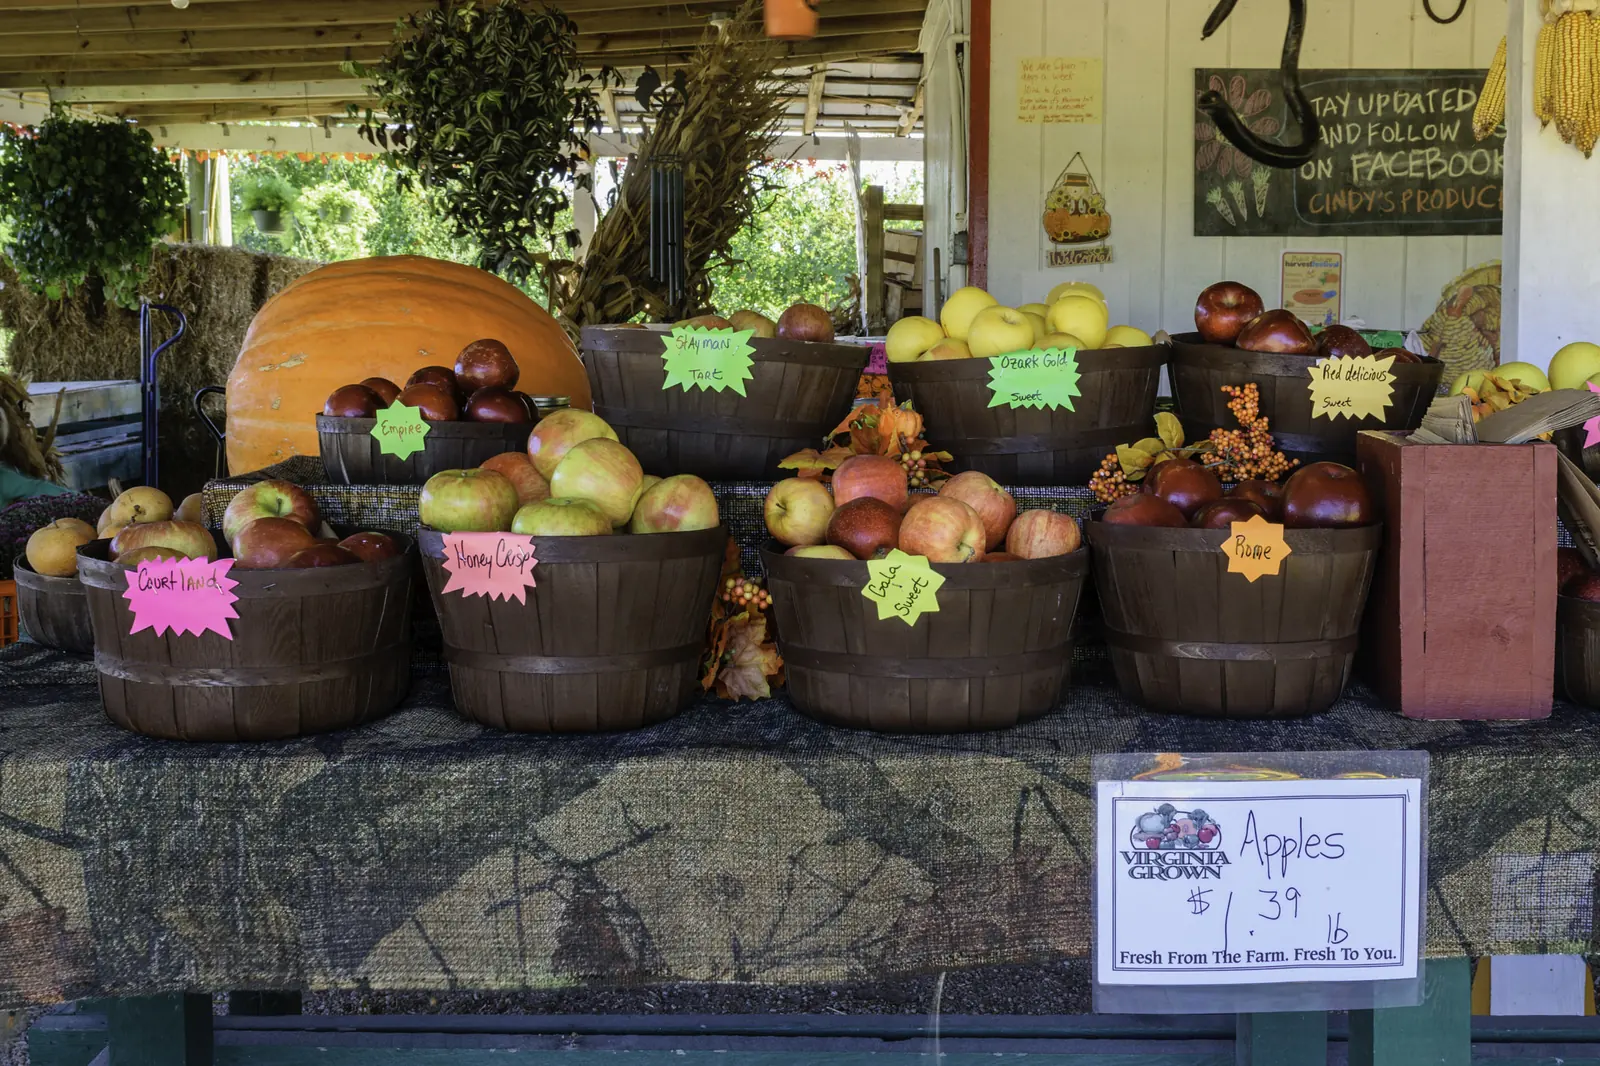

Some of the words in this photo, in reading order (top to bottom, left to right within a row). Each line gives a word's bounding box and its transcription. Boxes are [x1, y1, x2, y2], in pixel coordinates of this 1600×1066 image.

[1309, 91, 1351, 118] TAY
[1358, 88, 1477, 117] UPDATED
[1367, 120, 1461, 147] FOLLOW
[1300, 157, 1333, 181] ON
[1308, 188, 1396, 215] CINDY'S
[1402, 185, 1504, 214] PRODUC
[1043, 351, 1068, 368] Gold
[1322, 363, 1342, 381] Red
[454, 539, 493, 579] Honey
[1235, 534, 1272, 560] Rome
[868, 565, 902, 598] Gala
[894, 576, 929, 617] Sweet
[1240, 809, 1345, 880] Apples
[1119, 850, 1232, 867] VIRGINIA
[1127, 865, 1224, 881] GROWN
[1327, 912, 1349, 945] lb
[1119, 950, 1163, 965] Fresh
[1167, 951, 1209, 965] From
[1212, 949, 1242, 964] The
[1246, 949, 1289, 963] Farm.
[1294, 946, 1336, 961] Fresh
[1340, 947, 1359, 961] To
[1363, 947, 1397, 960] You.
